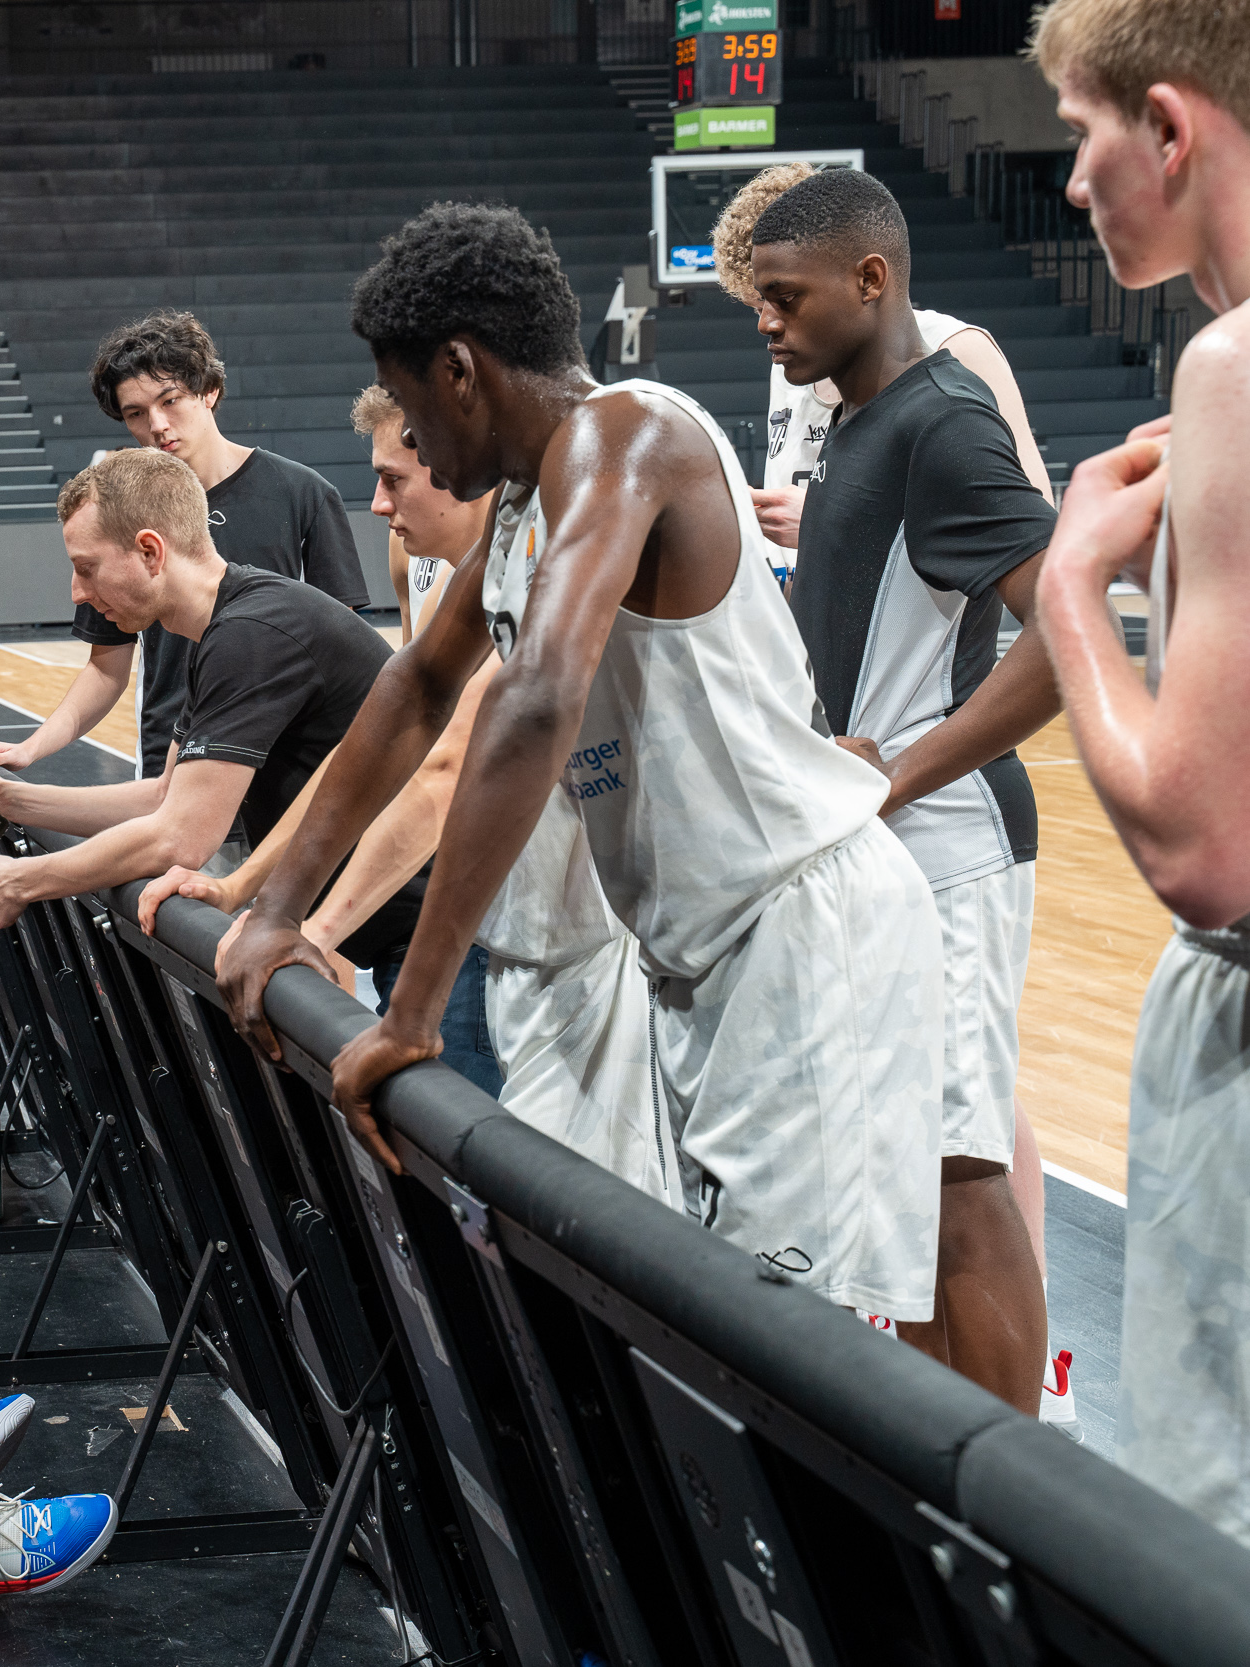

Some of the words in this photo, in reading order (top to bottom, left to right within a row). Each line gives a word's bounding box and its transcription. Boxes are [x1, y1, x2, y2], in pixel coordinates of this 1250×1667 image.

[723, 33, 778, 60] 3:59
[730, 62, 765, 96] 14
[707, 119, 768, 134] BARMER
